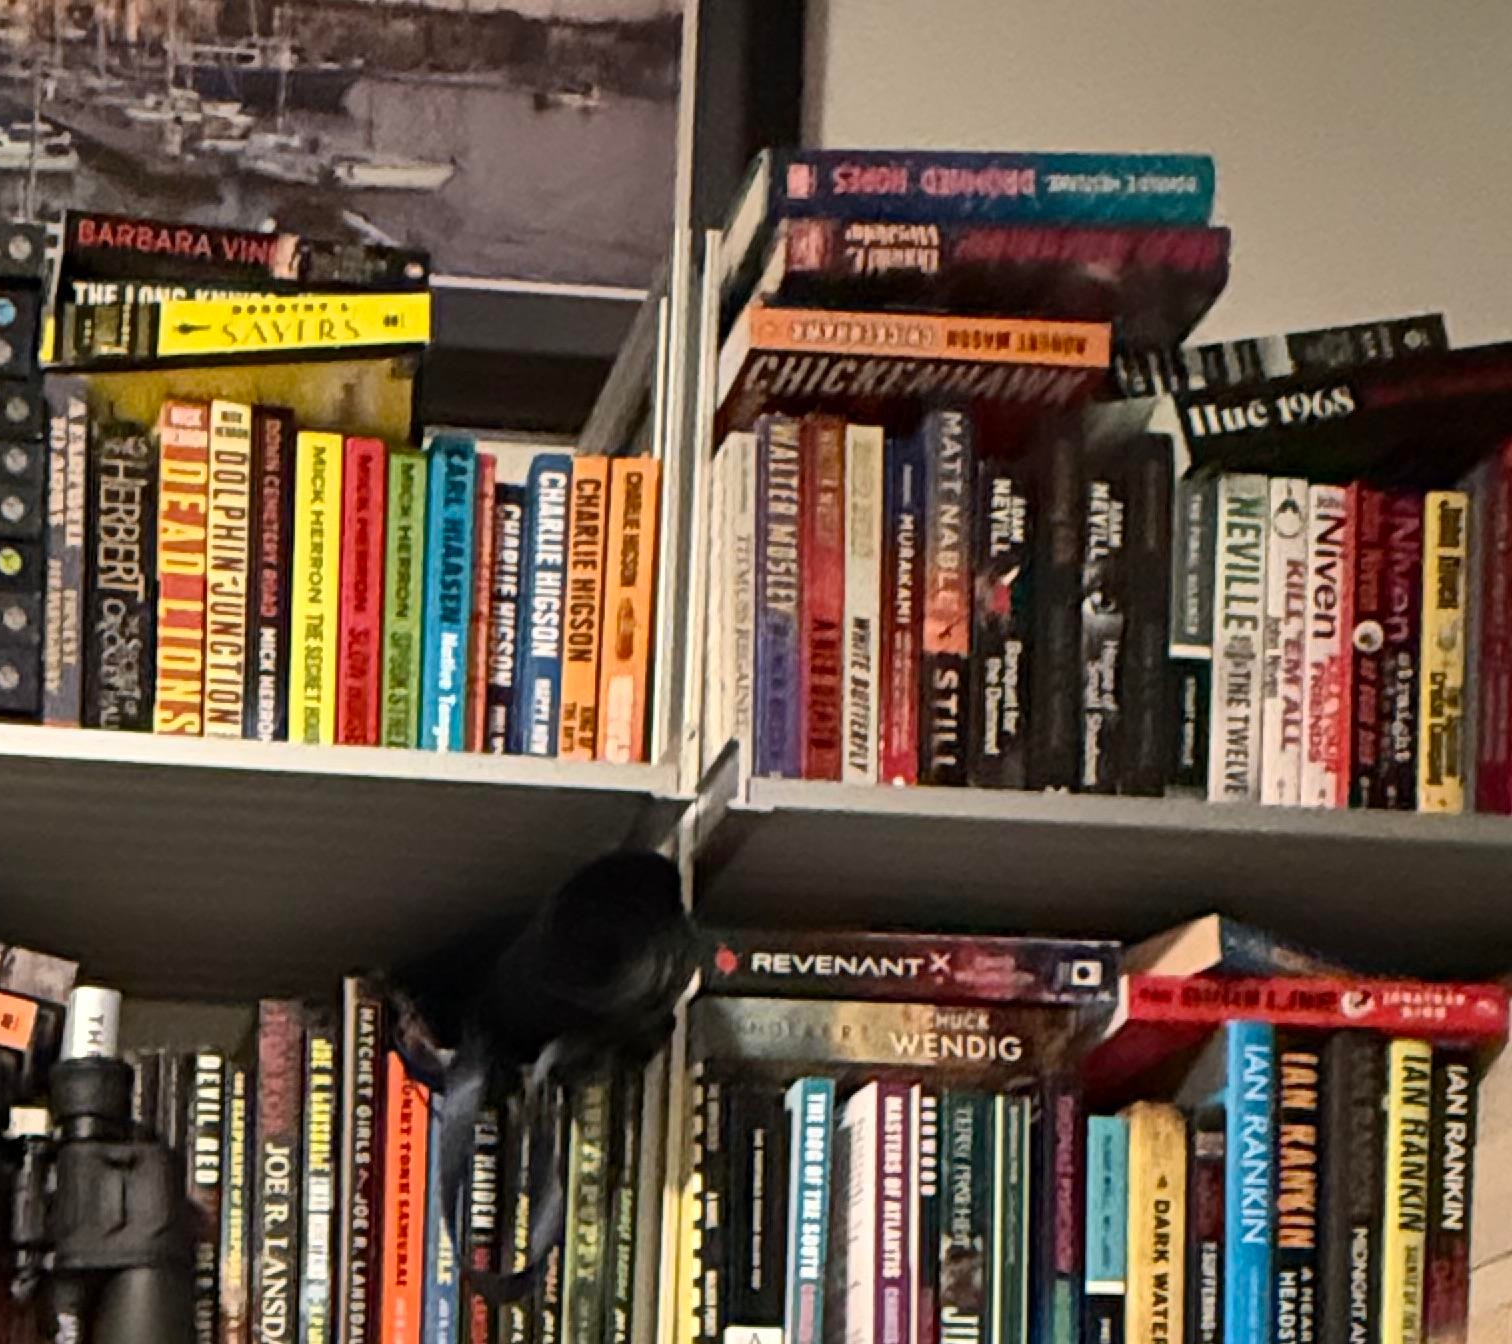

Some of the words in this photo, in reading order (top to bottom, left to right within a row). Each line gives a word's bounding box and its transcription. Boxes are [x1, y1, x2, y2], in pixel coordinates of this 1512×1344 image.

[77, 219, 213, 258] BARBARA
[221, 319, 361, 343] SAYERS
[1277, 385, 1356, 423] 1968
[212, 447, 248, 572] DOLPHIN
[311, 446, 326, 507] MICK
[99, 458, 146, 602] HERBERT
[163, 461, 204, 575] DEAD
[307, 512, 324, 605] HERRON
[534, 472, 566, 565] CHARLIE
[573, 477, 602, 572] CHARLIE
[1221, 495, 1260, 636] NEVILLE
[1313, 513, 1346, 640] Niven
[208, 583, 245, 724] JUNCTION
[531, 570, 560, 659] HIGSON
[568, 575, 596, 663] HIGSON
[159, 599, 202, 733] LIONS
[1226, 670, 1250, 709] THE
[1221, 715, 1254, 796] TWELVE
[751, 952, 925, 978] REVENANT
[926, 951, 952, 975] X
[357, 1006, 374, 1102] HATCHET
[889, 1031, 1023, 1060] WENDIG
[1248, 1043, 1273, 1101] IAN
[194, 1054, 221, 1130] DEVIL
[1445, 1064, 1471, 1116] IAN
[194, 1138, 219, 1186] RED
[262, 1142, 290, 1194] JOE
[354, 1105, 372, 1166] GIRLS
[1442, 1122, 1469, 1230] RANKIN
[263, 1206, 289, 1234] R.
[1241, 1115, 1270, 1244] RANKIN
[1151, 1198, 1171, 1263] DARK
